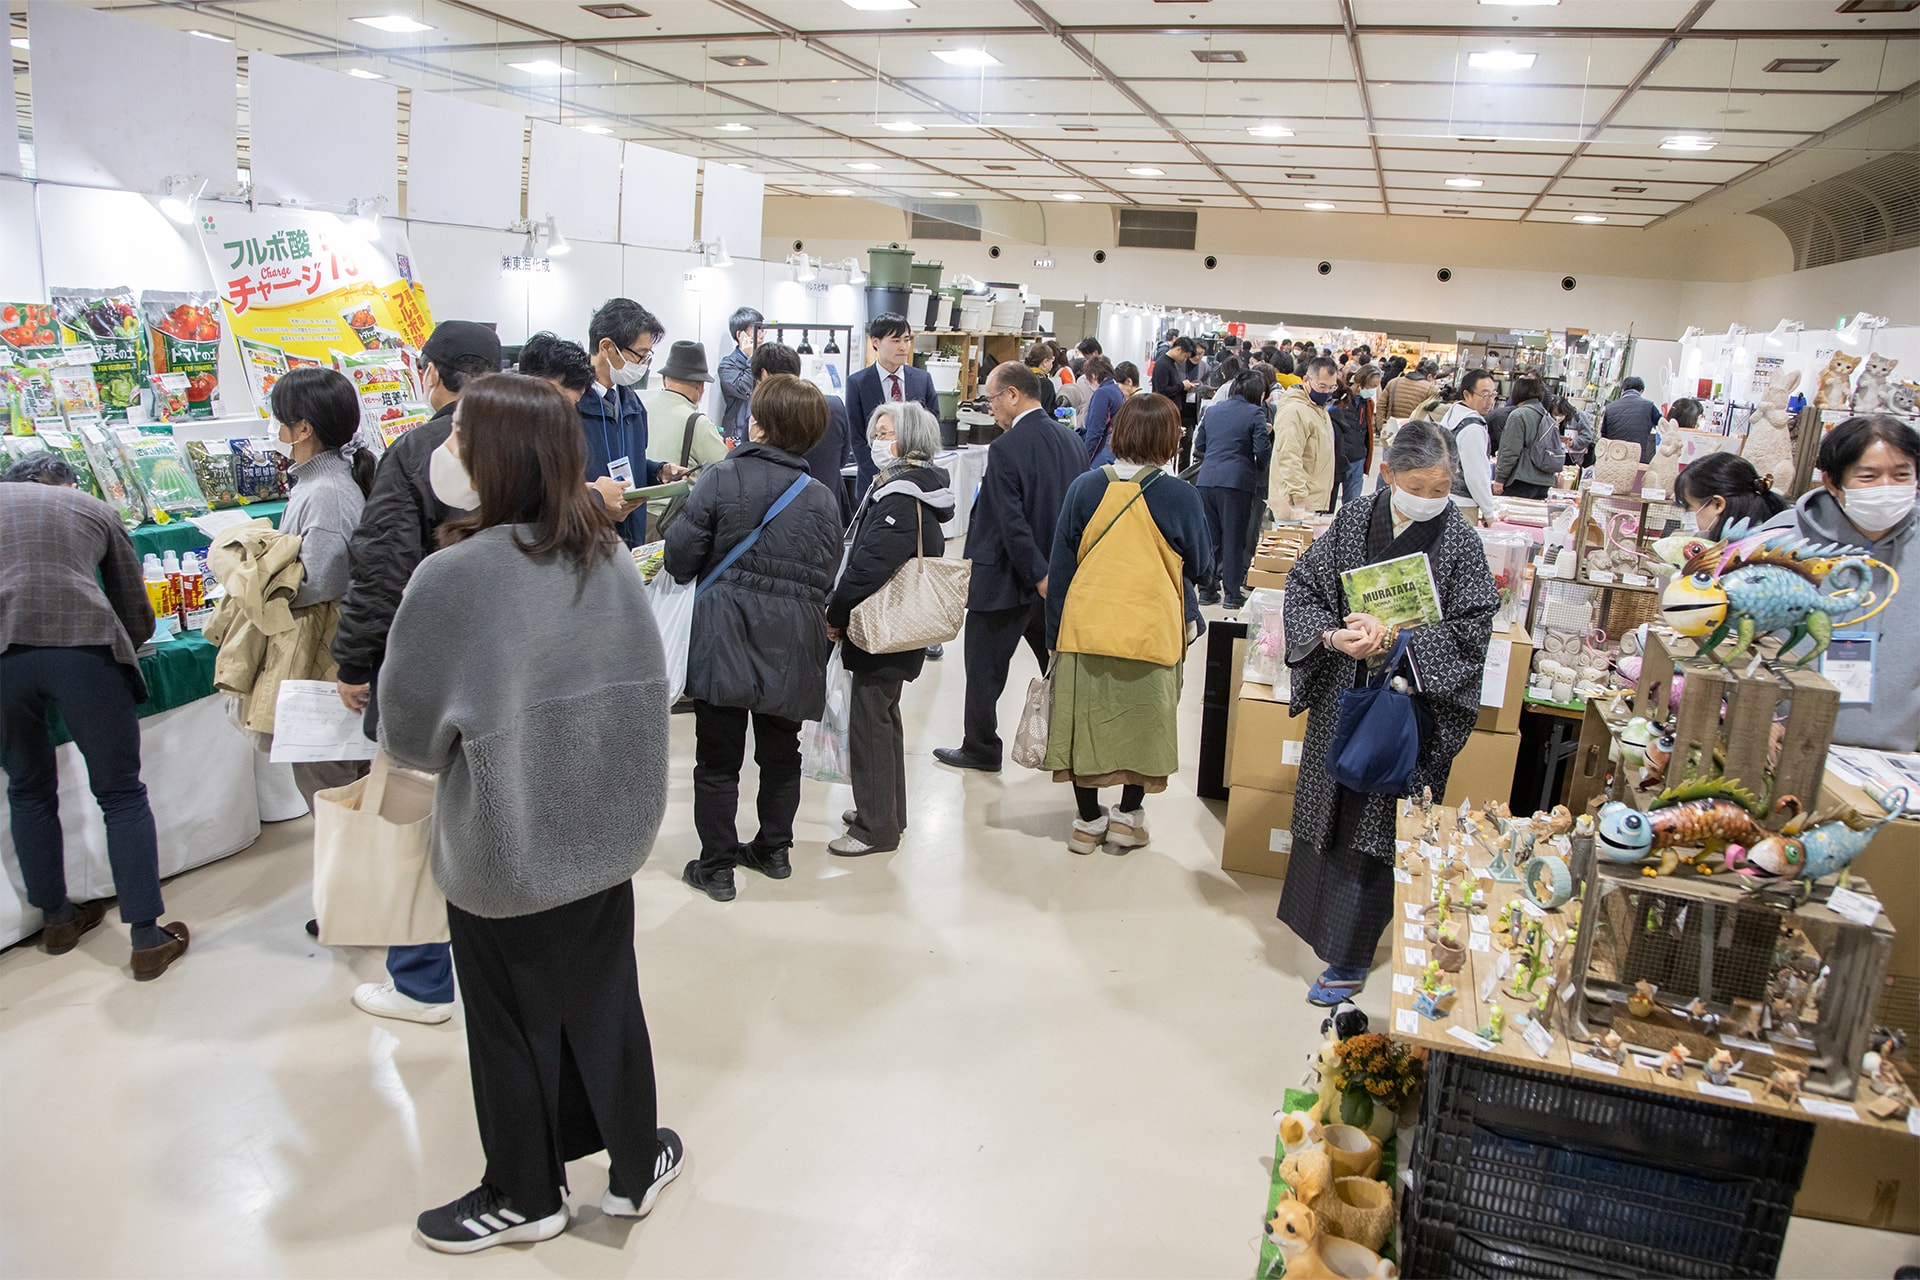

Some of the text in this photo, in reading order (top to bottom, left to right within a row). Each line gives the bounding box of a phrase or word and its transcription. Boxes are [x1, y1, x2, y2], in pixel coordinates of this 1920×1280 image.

[223, 229, 313, 270] フルボ酸
[260, 266, 291, 280] Charge
[228, 262, 321, 315] チャージ
[171, 346, 217, 363] トマトの土
[1362, 581, 1416, 604] MURATAYA
